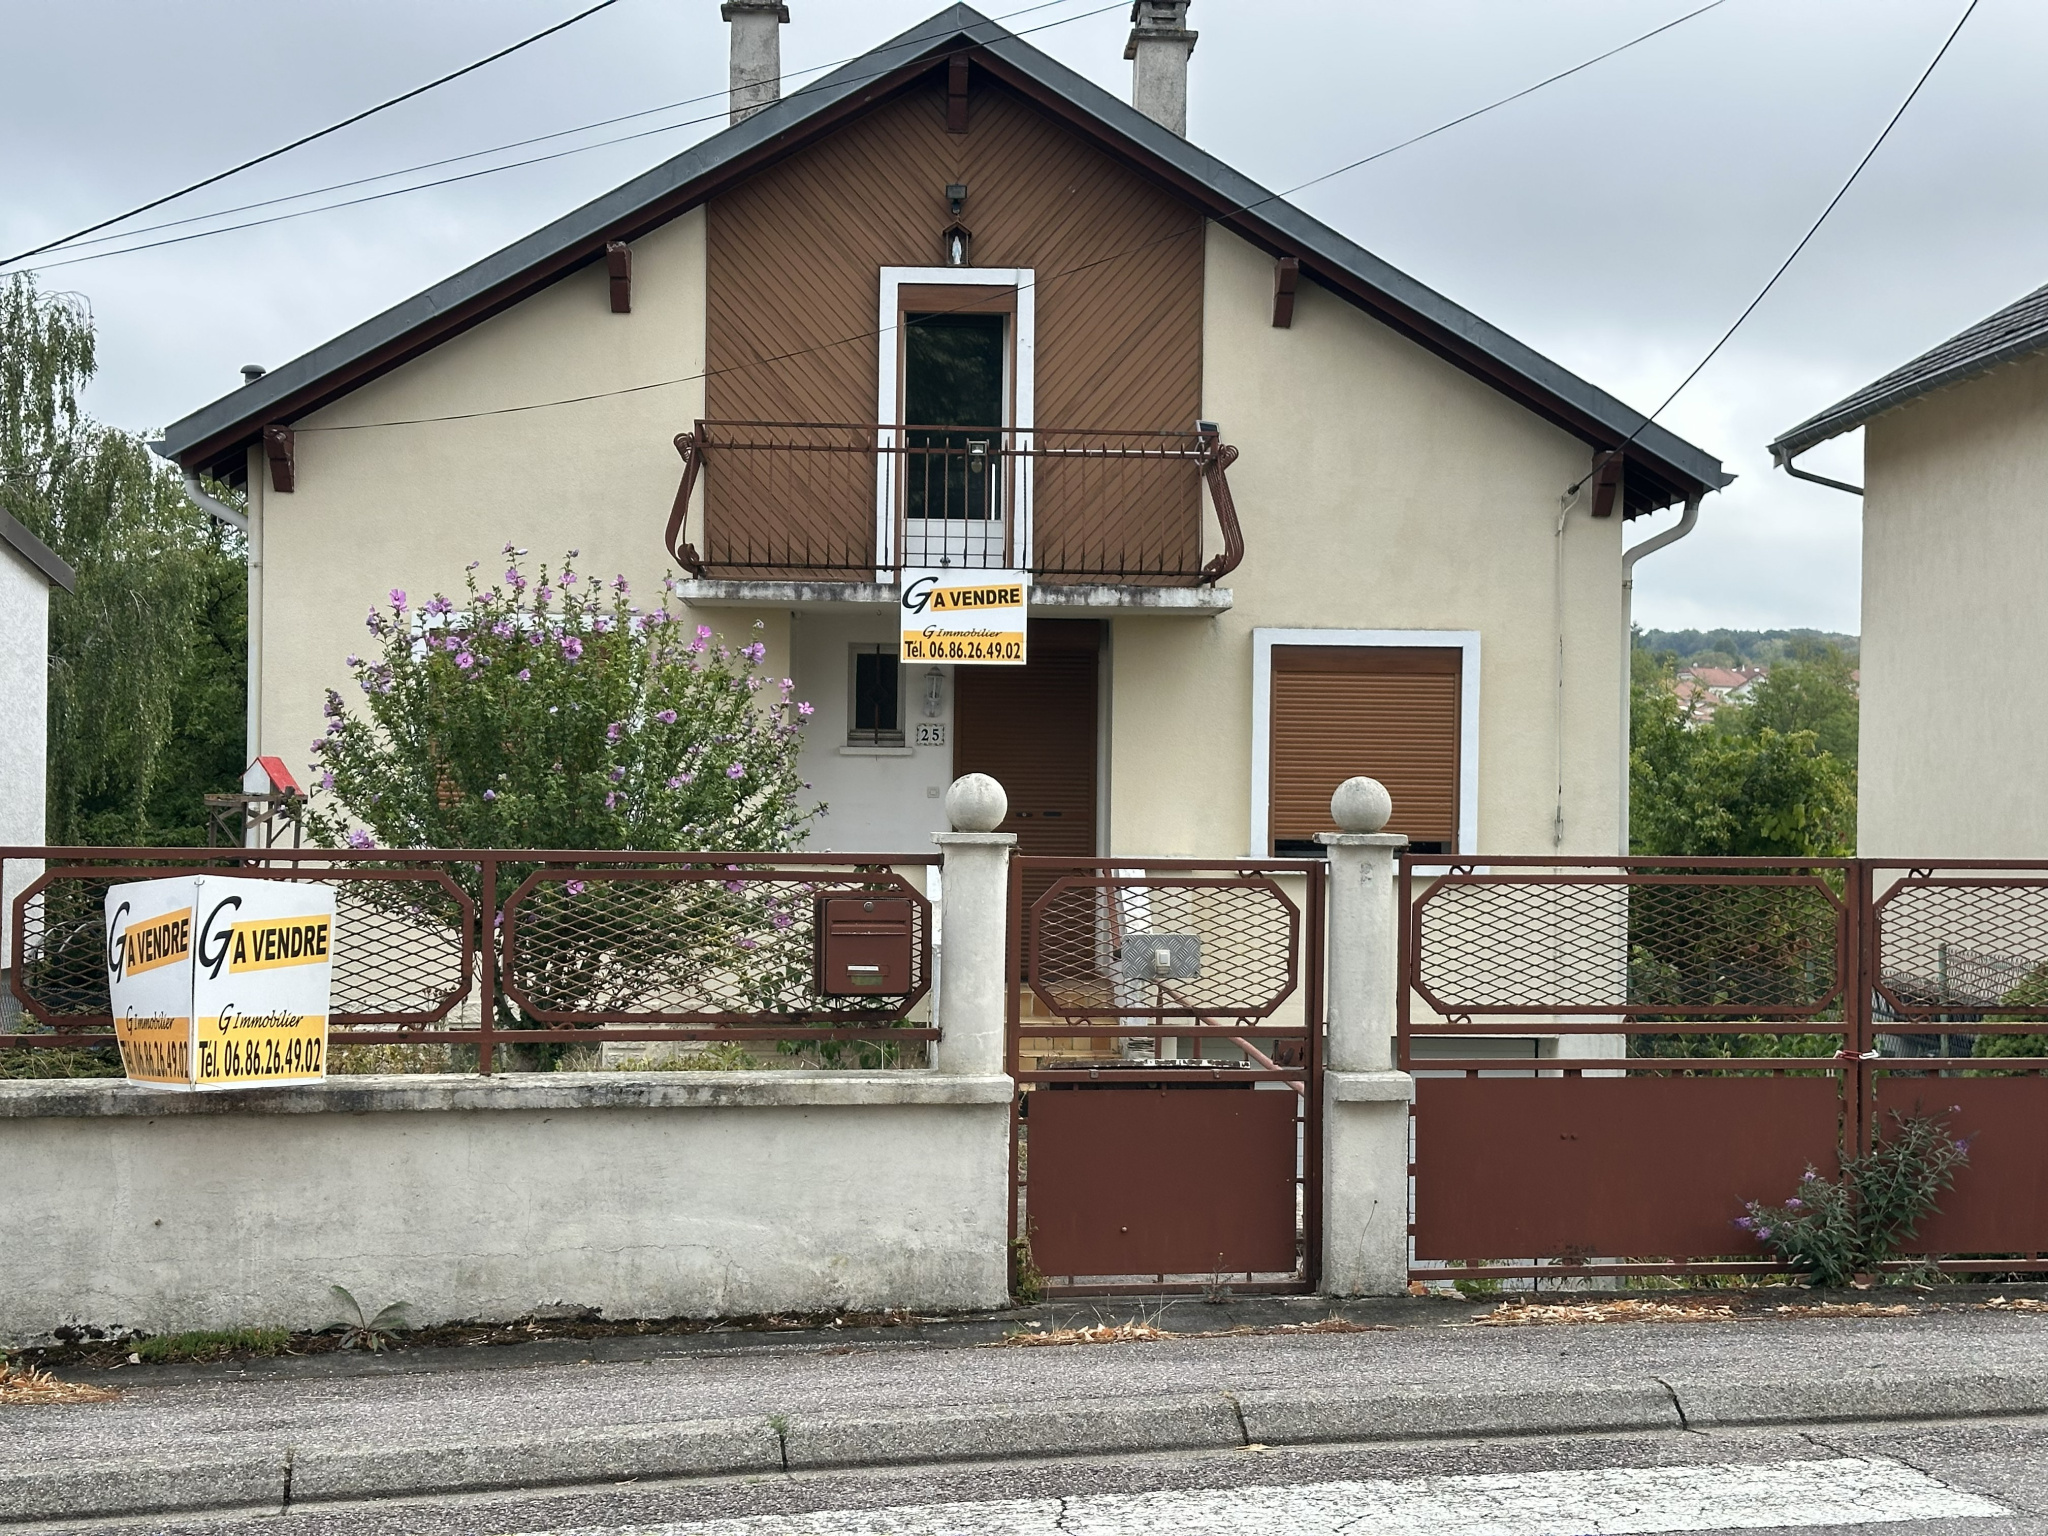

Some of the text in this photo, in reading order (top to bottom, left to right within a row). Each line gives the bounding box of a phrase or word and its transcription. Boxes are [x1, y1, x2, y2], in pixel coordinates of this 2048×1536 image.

[933, 592, 946, 608] A
[949, 588, 1021, 607] VENDRE
[904, 640, 1021, 659] Tél. 06.86.26.49.02
[921, 729, 940, 741] 25
[128, 935, 136, 968] A
[137, 918, 190, 964] VENDRE
[233, 931, 246, 964] A
[252, 924, 328, 962] VENDRE
[199, 1037, 321, 1078] Tél. 06.86.26.49.02
